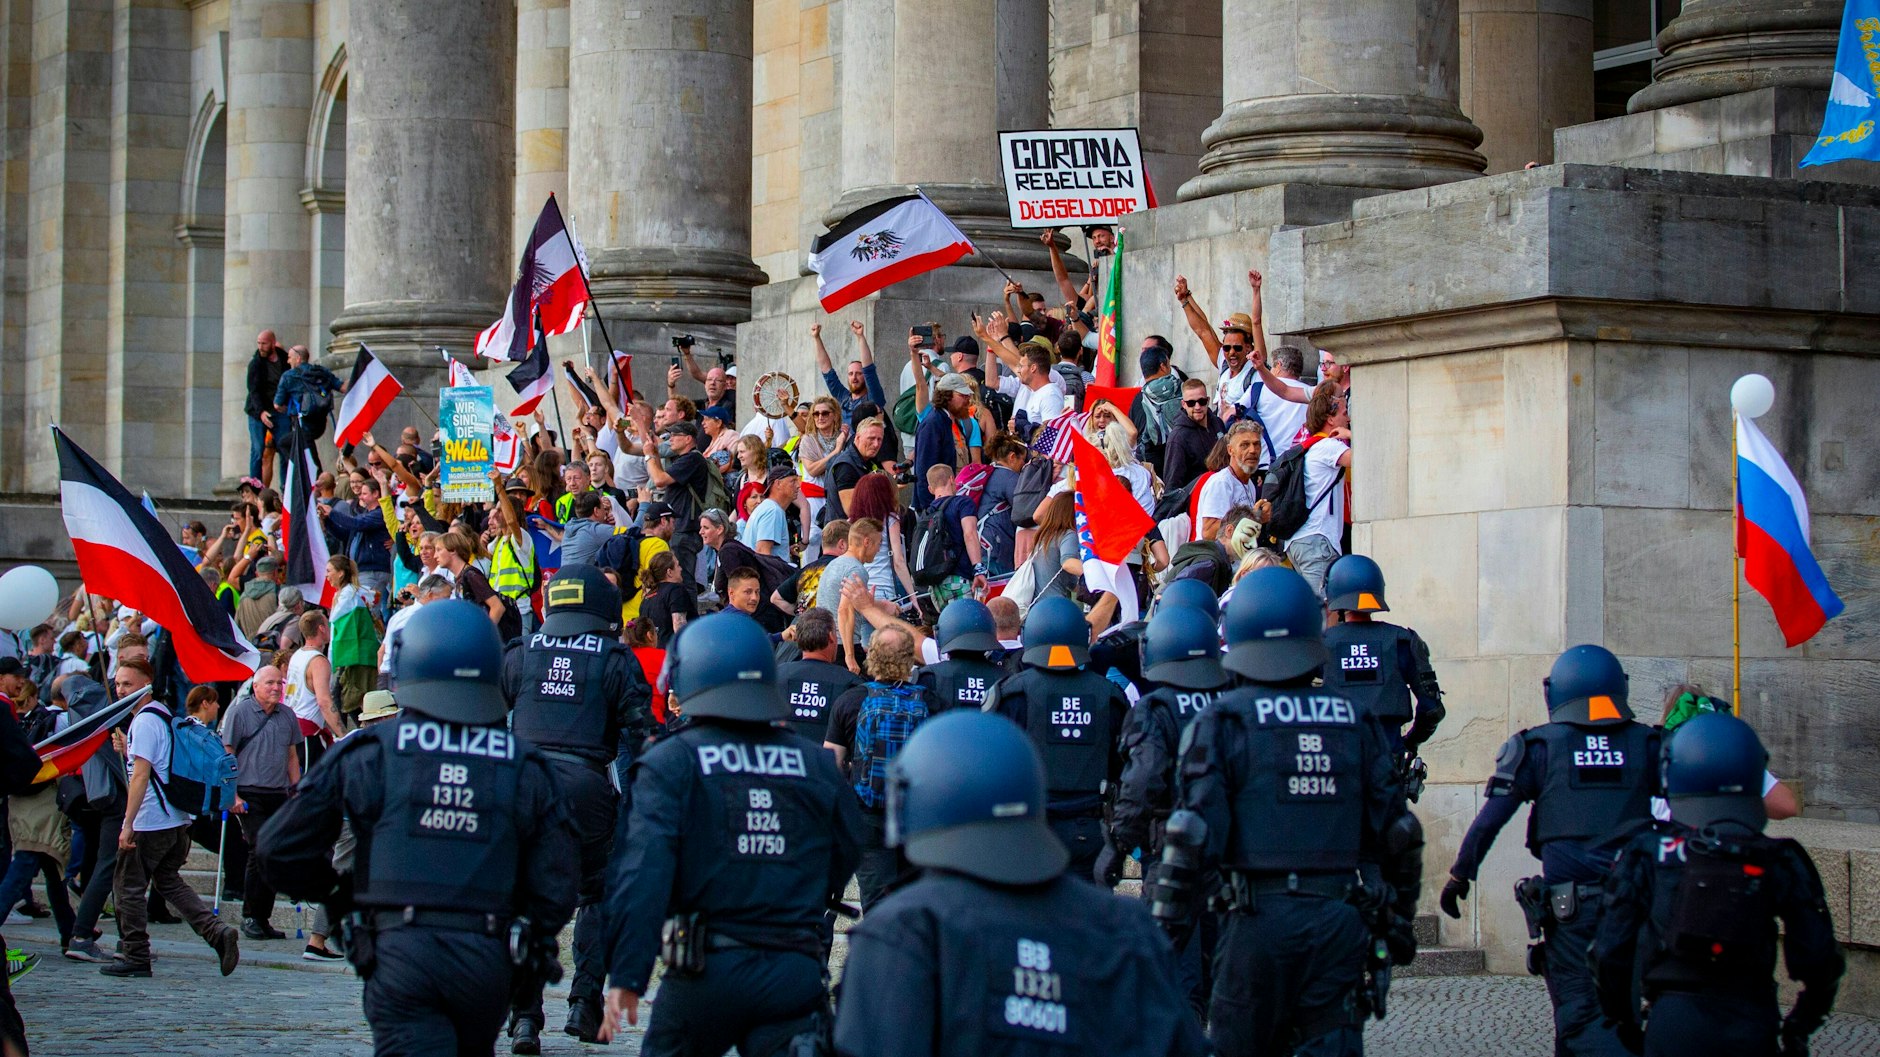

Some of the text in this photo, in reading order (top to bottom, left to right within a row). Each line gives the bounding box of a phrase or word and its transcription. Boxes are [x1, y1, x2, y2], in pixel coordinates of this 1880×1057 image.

[1010, 138, 1132, 170] CORONA
[1015, 169, 1135, 191] REBELLEN
[455, 401, 475, 413] WIR
[452, 413, 478, 426] SIND
[457, 426, 474, 439] DIE
[1350, 644, 1368, 656] BE
[552, 656, 571, 669] BB
[1340, 656, 1379, 669] E1235
[547, 668, 574, 682] 1312
[967, 677, 985, 689] BE
[541, 681, 576, 697] 35645
[802, 682, 819, 695] BE
[790, 693, 827, 708] E1200
[1062, 697, 1081, 711] BE
[1255, 695, 1356, 724] POLIZEI
[1051, 711, 1092, 725] E1210
[397, 721, 516, 760] POLIZEI
[1298, 733, 1323, 753] BB
[1585, 735, 1610, 750] BE
[697, 742, 808, 778] POLIZEI
[1295, 753, 1331, 773] 1313
[1573, 751, 1625, 766] E1213
[438, 763, 469, 786] BB
[1288, 775, 1337, 795] 98314
[431, 784, 475, 809] 1312
[748, 788, 773, 809] BB
[419, 808, 479, 834] 46075
[745, 811, 781, 832] 1324
[737, 834, 786, 856] 81750
[1017, 937, 1051, 971] BB
